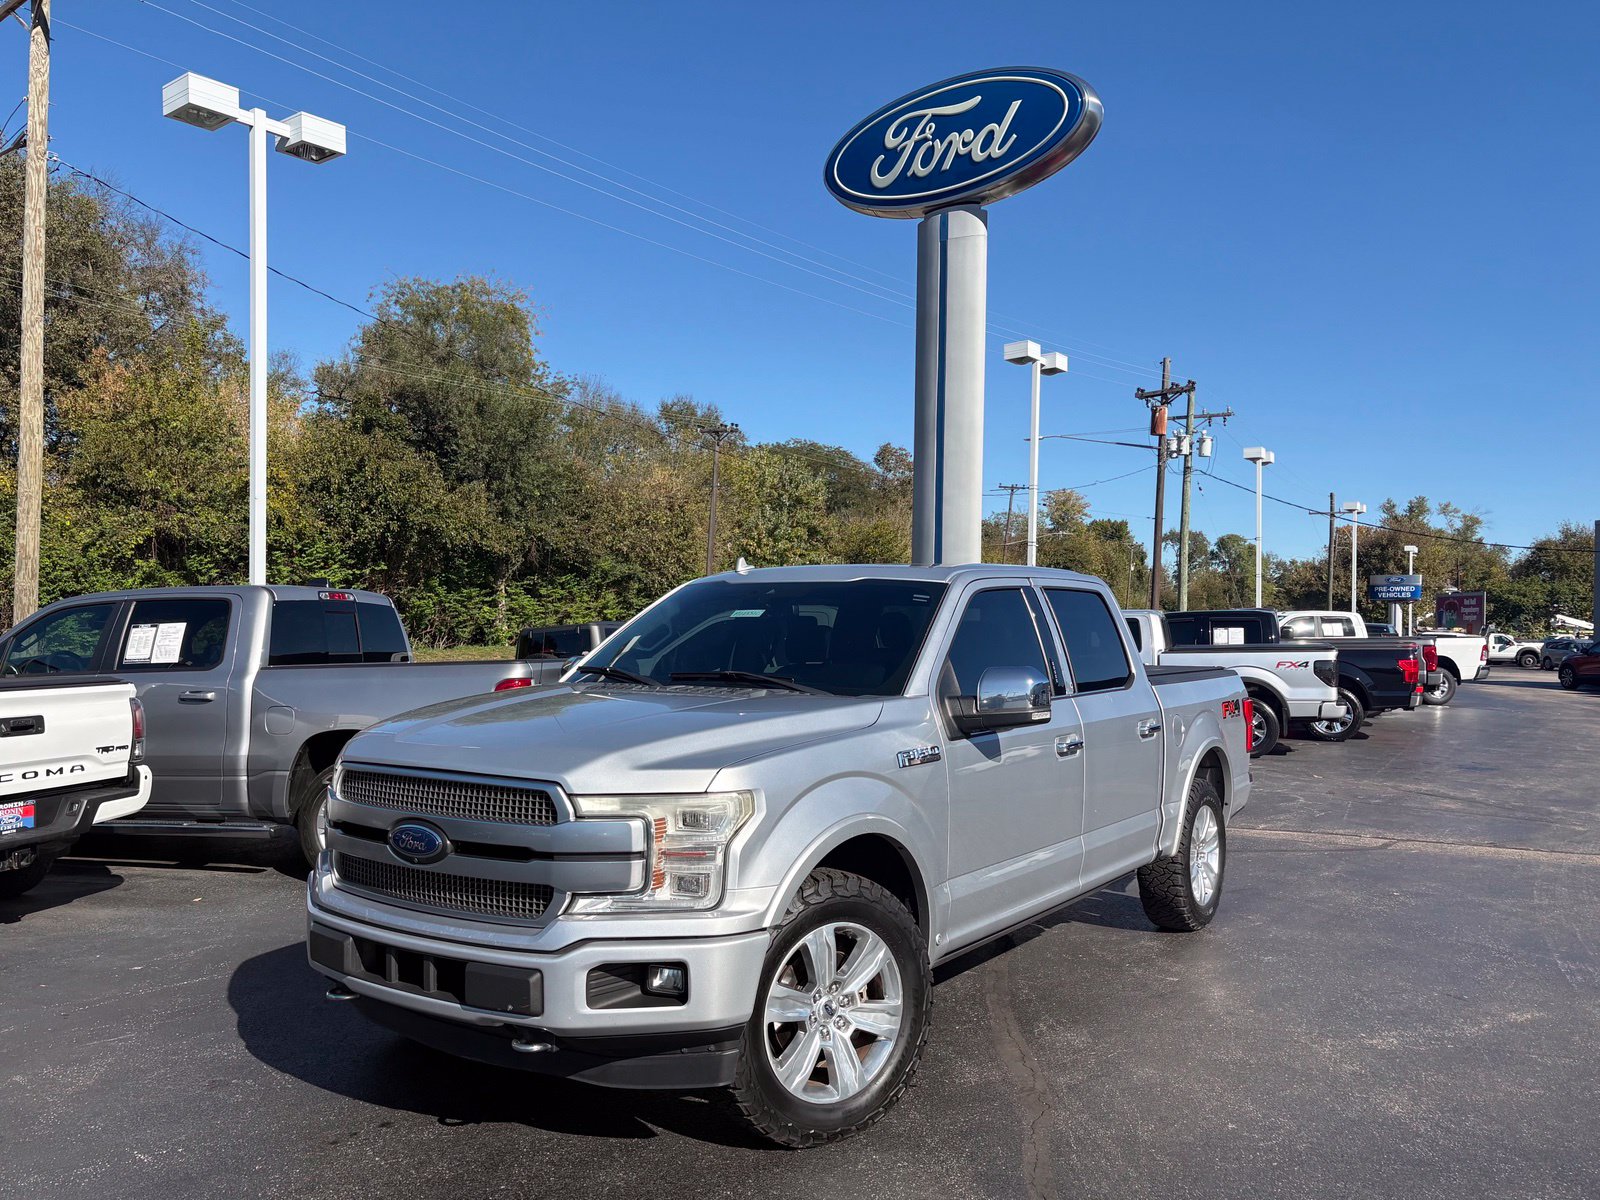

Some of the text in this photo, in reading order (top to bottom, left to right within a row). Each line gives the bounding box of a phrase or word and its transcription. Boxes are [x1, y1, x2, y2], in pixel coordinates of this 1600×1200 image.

[870, 95, 1023, 189] Ford
[1275, 660, 1310, 669] FX4
[1221, 699, 1241, 719] FX4
[399, 830, 428, 851] Ford
